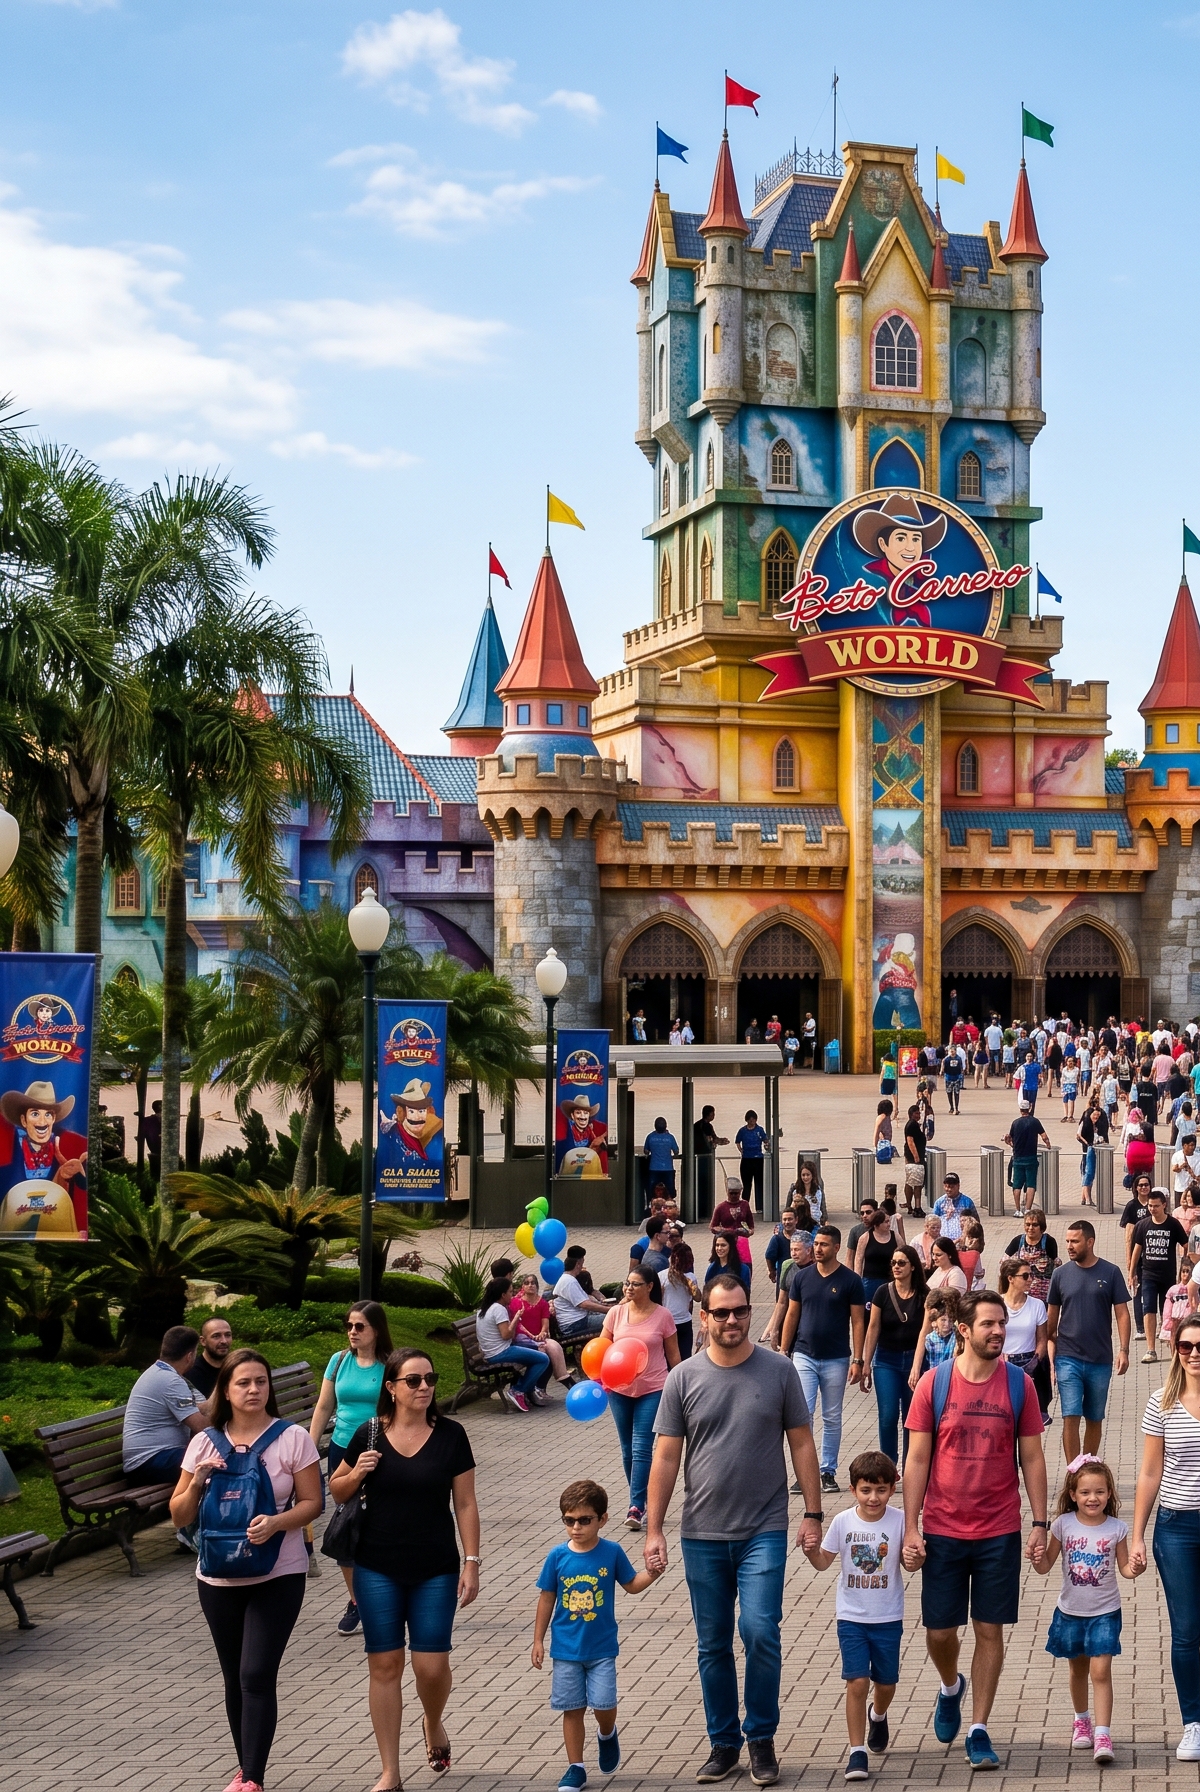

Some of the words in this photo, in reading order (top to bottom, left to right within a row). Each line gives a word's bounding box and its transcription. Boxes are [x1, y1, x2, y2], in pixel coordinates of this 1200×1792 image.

[773, 570, 885, 631] Beto
[888, 560, 1032, 608] Carrero
[824, 635, 979, 670] WORLD
[13, 1040, 72, 1053] WORLD
